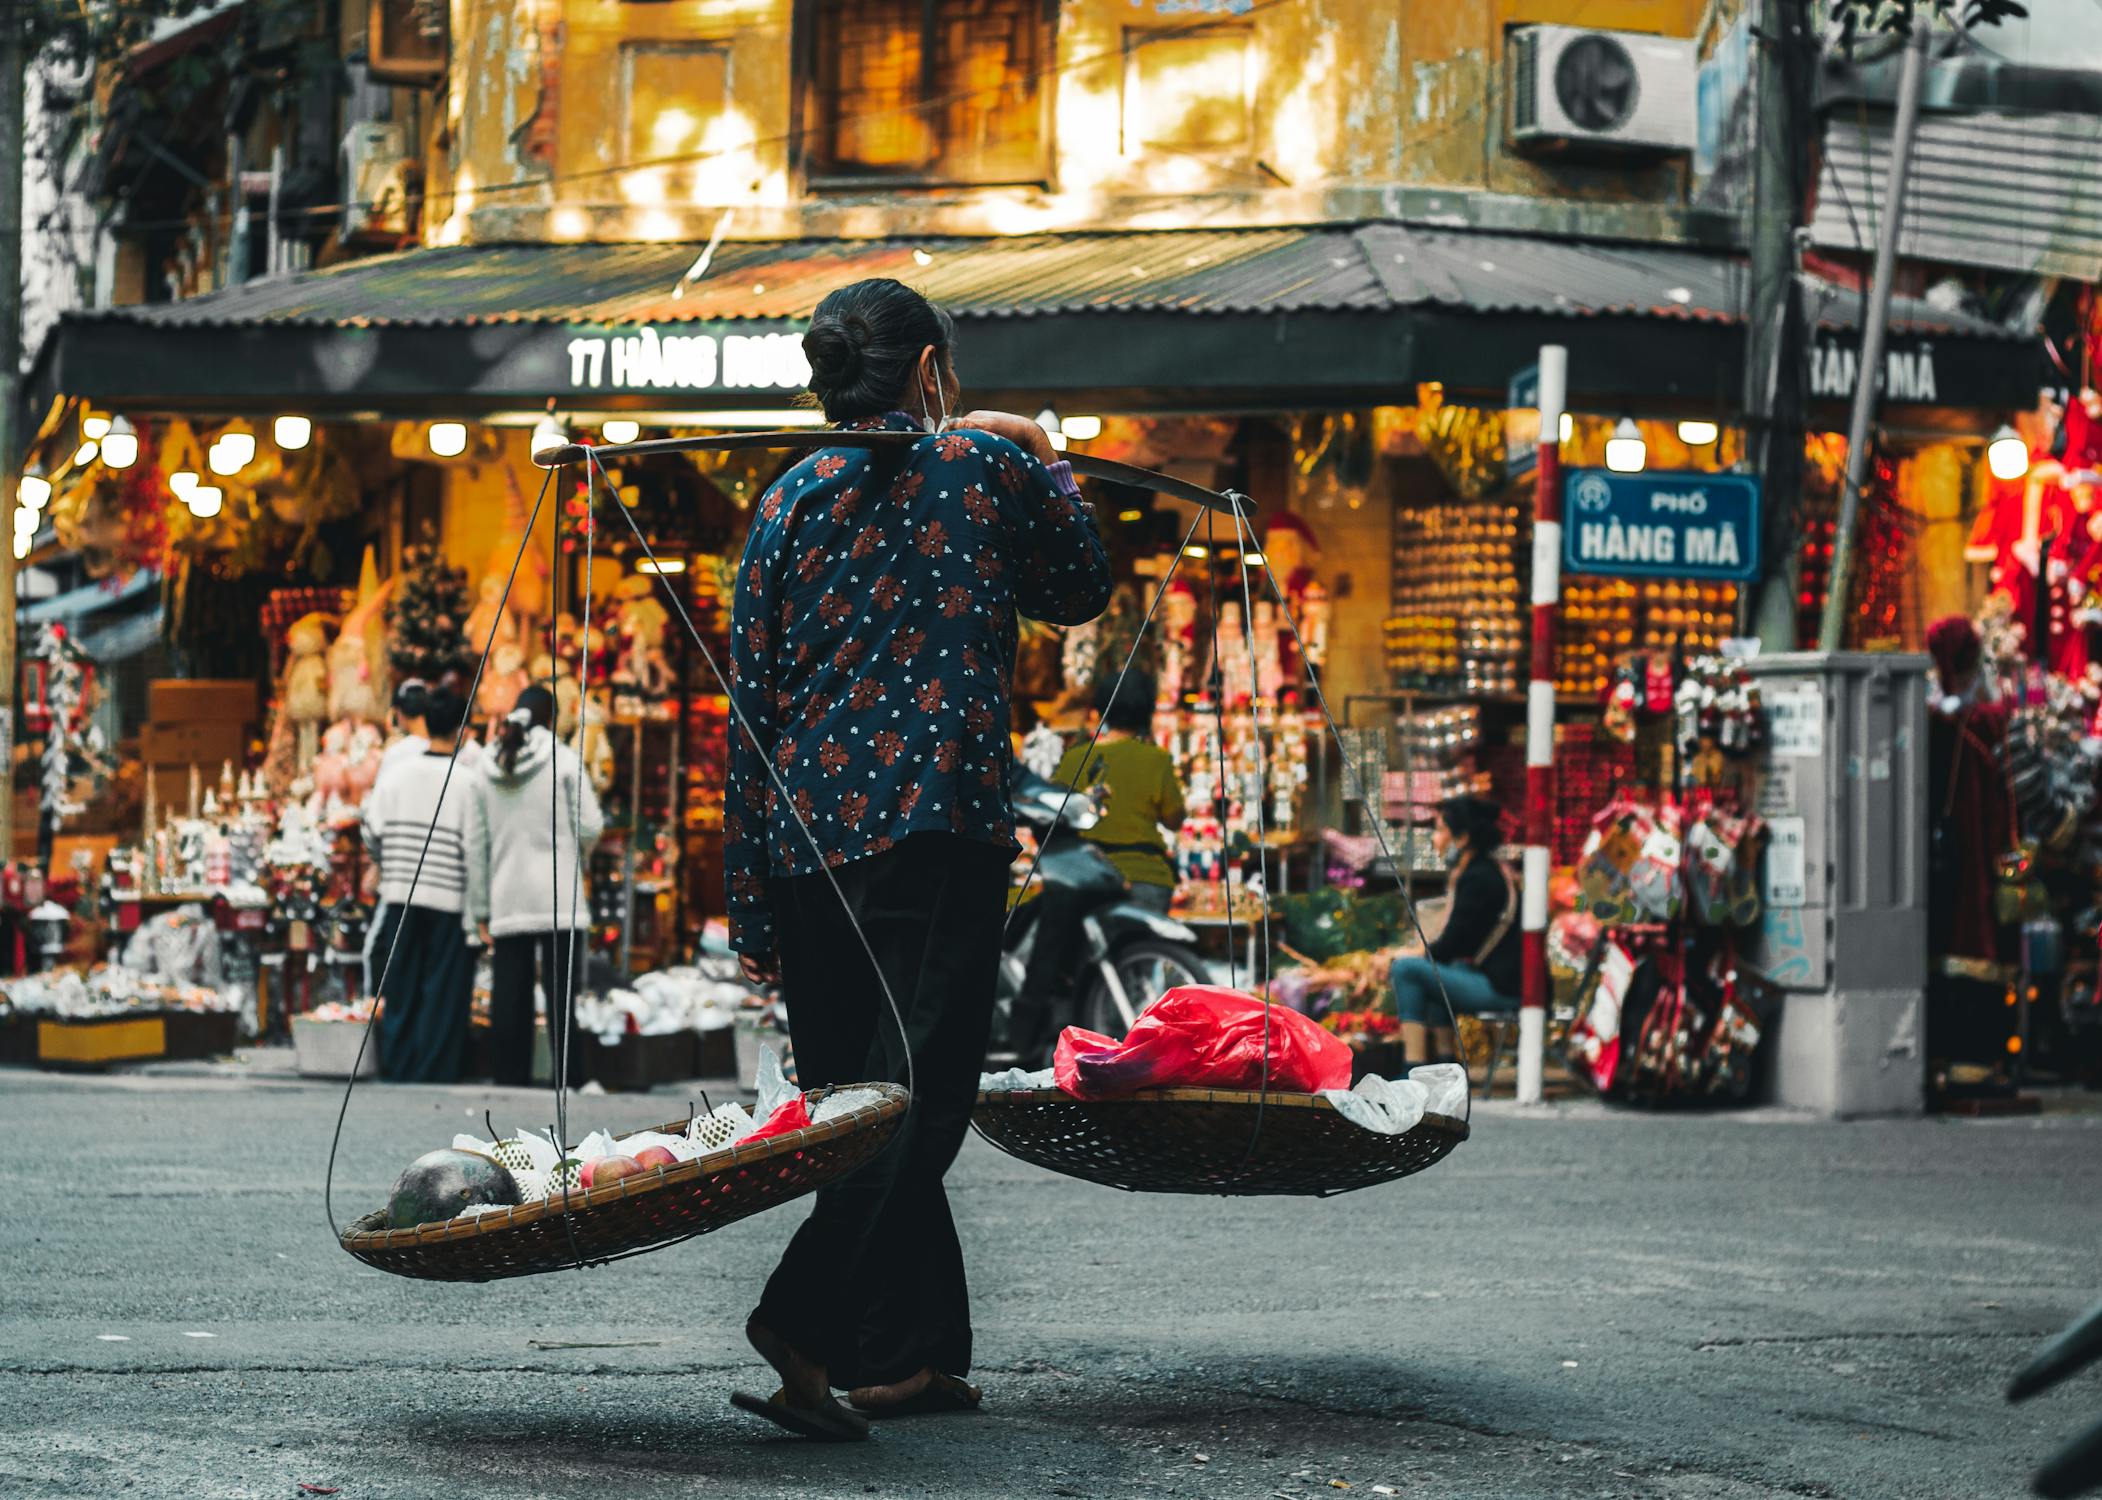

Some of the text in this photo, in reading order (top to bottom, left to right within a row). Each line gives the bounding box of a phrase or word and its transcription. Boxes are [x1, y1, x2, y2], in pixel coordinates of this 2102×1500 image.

[568, 338, 606, 387] 17
[612, 327, 718, 388] HÀNG
[1580, 515, 1739, 564] HÀNG MÃ
